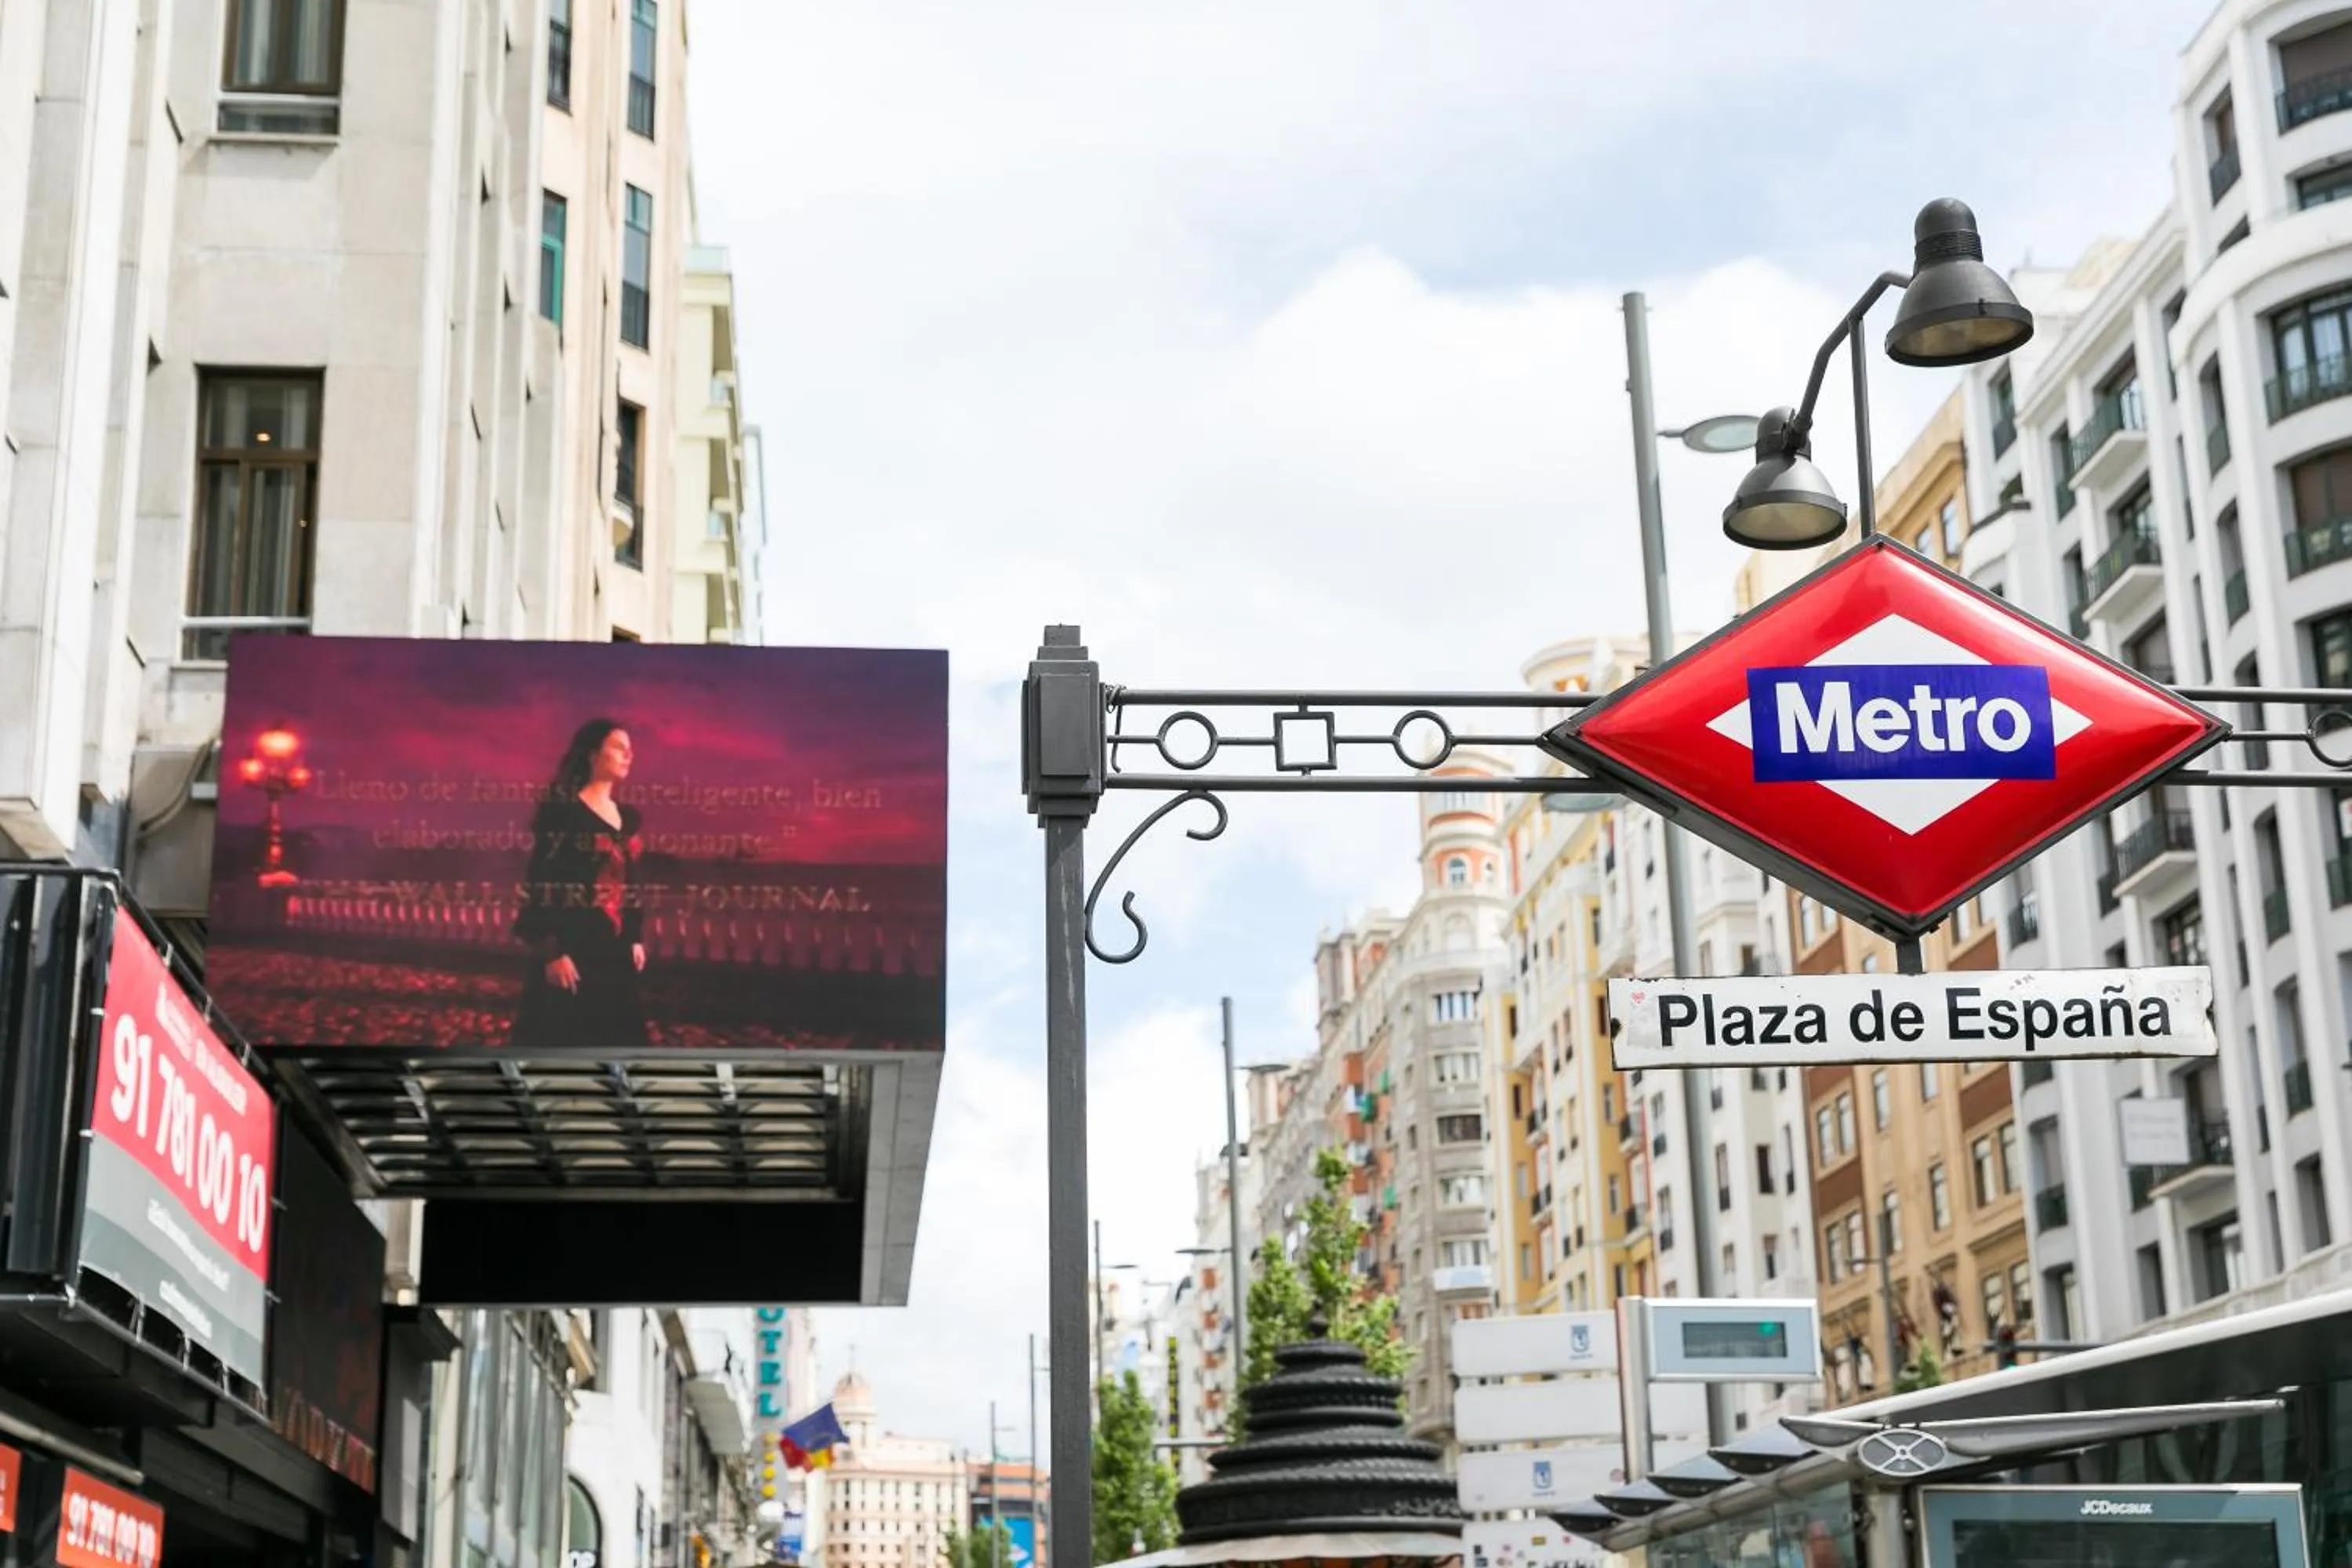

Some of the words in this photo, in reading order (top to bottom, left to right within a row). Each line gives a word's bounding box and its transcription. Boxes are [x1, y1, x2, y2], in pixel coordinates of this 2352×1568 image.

[1775, 681, 2031, 753] Metro
[419, 769, 459, 801] de
[813, 777, 882, 809] bien
[372, 819, 536, 851] elaborado
[546, 831, 565, 859] y
[390, 880, 503, 909] WALL
[514, 880, 670, 911] STREET
[676, 883, 871, 916] JOURNAL
[1657, 993, 1829, 1048] Plaza
[1849, 989, 1925, 1044] de
[1945, 985, 2172, 1051] España
[111, 1013, 153, 1138] 91
[155, 1053, 198, 1189] 781
[198, 1112, 234, 1225] 00
[238, 1152, 267, 1253] 10
